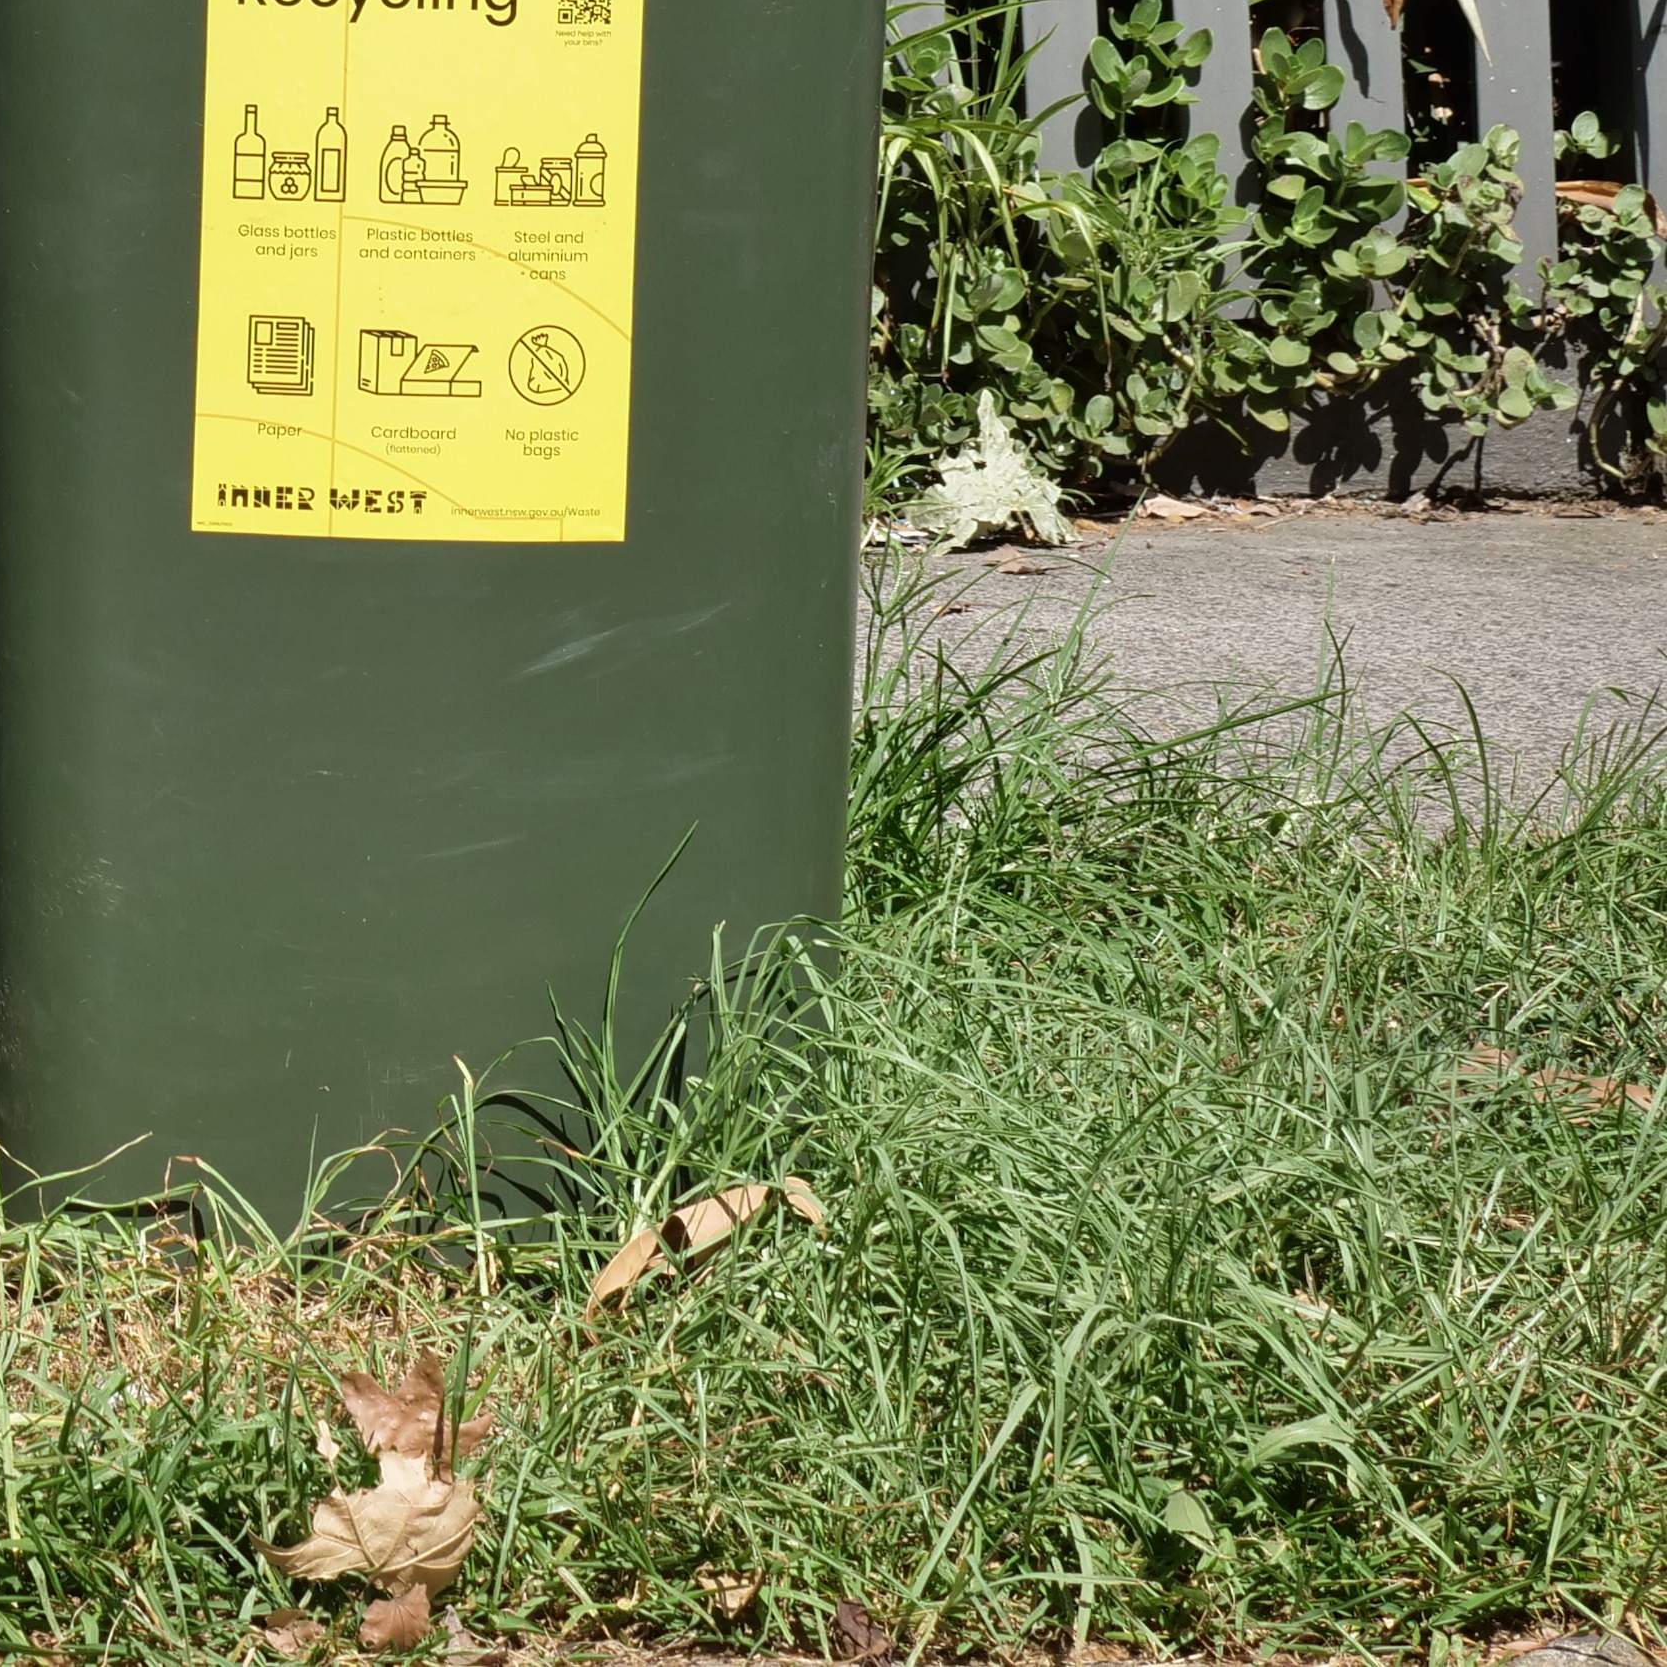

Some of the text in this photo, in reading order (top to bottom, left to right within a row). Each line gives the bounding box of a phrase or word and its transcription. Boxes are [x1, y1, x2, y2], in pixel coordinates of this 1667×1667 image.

[577, 31, 594, 39] help
[238, 224, 336, 240] Glass bottles
[367, 228, 473, 244] Plastic bottles
[514, 230, 583, 244] Steel and
[255, 243, 317, 260] and jars
[359, 246, 476, 261] and containers
[508, 248, 588, 263] aluminium
[530, 269, 566, 281] cans
[258, 423, 302, 439] Paper
[371, 426, 456, 441] Cardboard
[505, 428, 579, 445] No plastic
[386, 443, 441, 456] (flattened)
[523, 443, 561, 459] bags
[218, 483, 427, 515] INNER WEST
